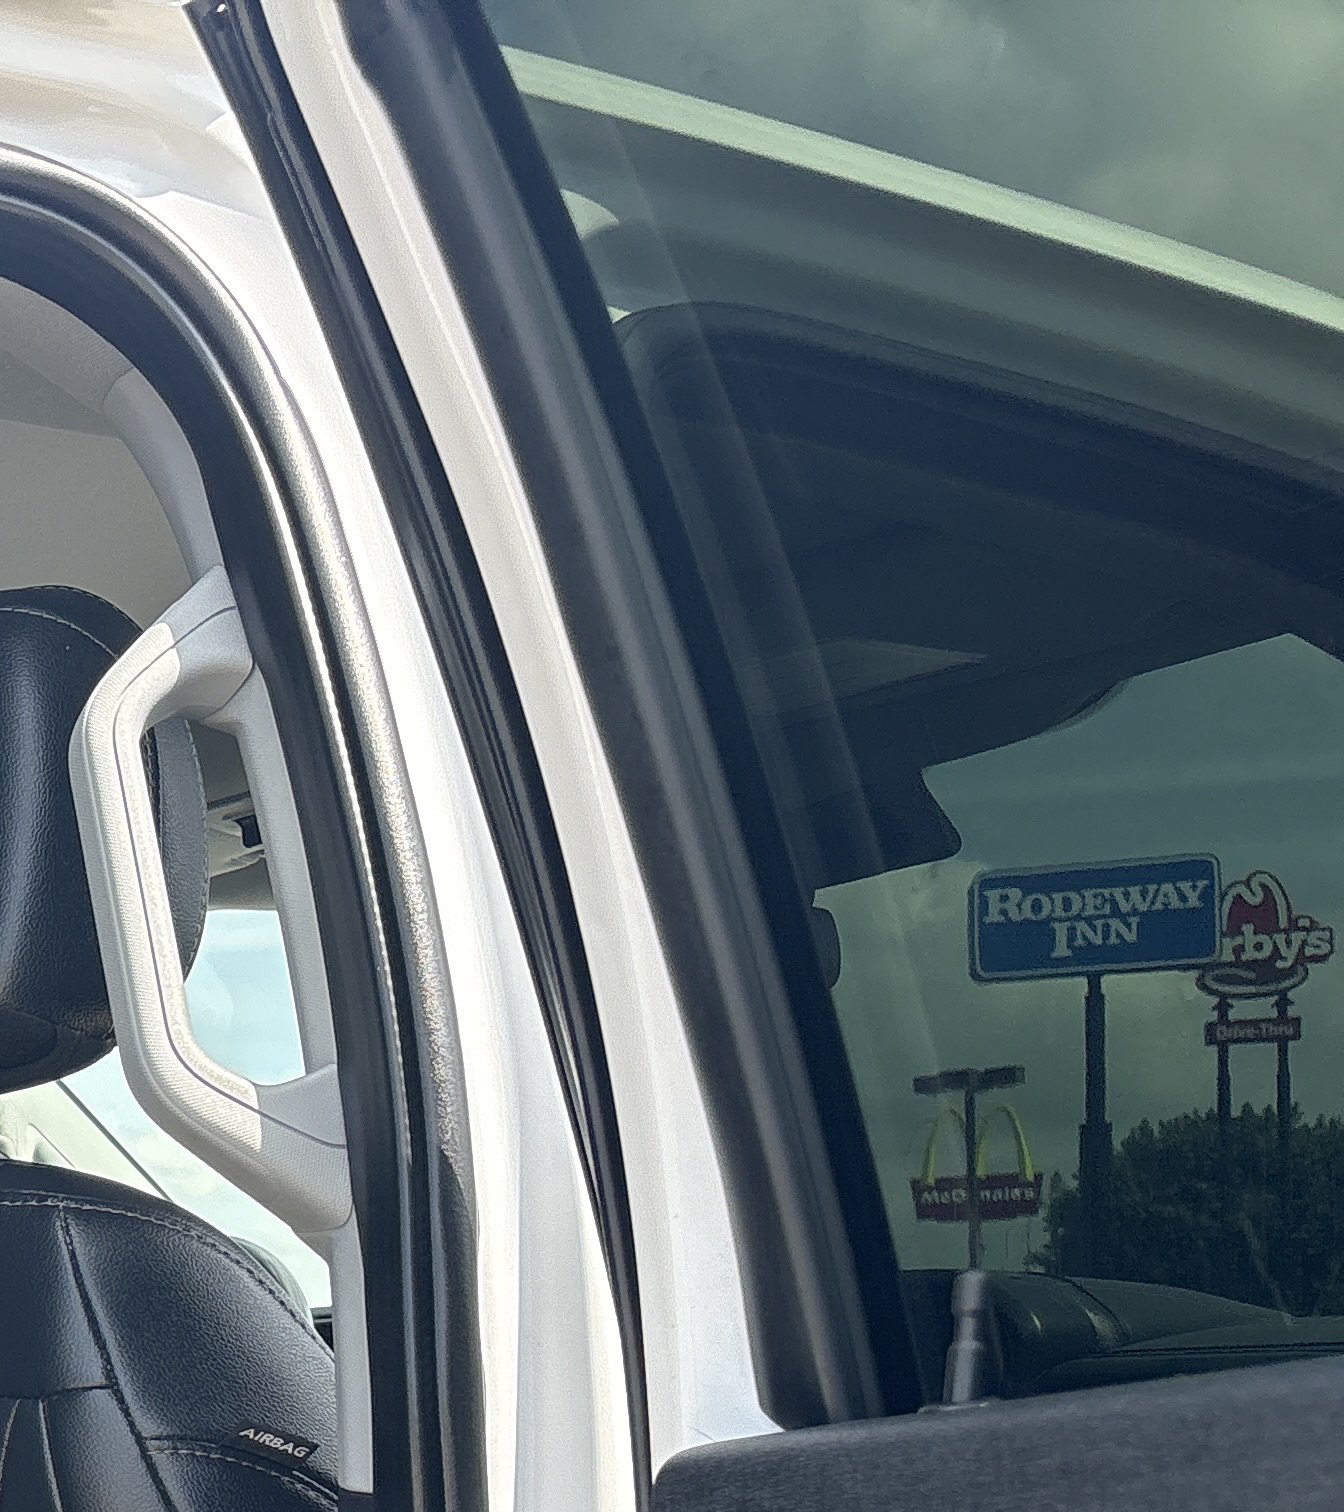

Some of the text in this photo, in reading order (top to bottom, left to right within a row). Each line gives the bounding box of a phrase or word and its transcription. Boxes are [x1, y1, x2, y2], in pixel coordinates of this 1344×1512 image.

[982, 879, 1210, 924] RODEWAY
[1050, 916, 1143, 959] INN
[1221, 916, 1333, 969] rby's
[920, 1185, 1035, 1206] McDnald's
[238, 1428, 310, 1458] AIRBAG
